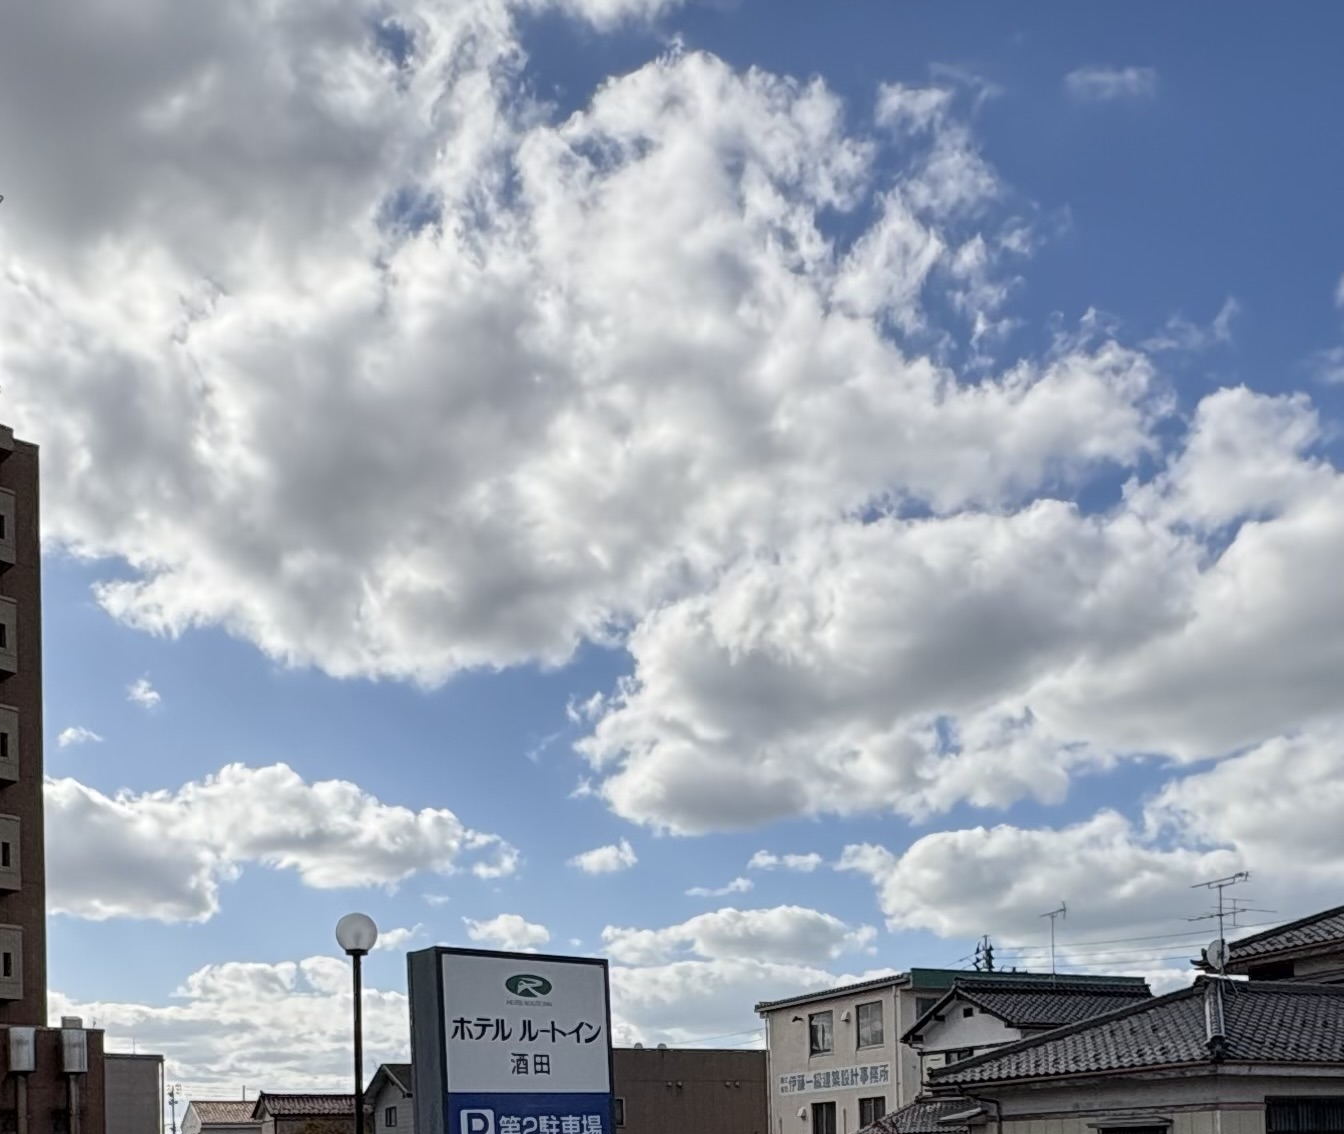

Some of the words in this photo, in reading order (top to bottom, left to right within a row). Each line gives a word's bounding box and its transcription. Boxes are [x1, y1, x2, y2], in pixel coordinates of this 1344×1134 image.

[451, 1017, 513, 1042] ホテル
[518, 1019, 602, 1044] ルートイン
[510, 1052, 551, 1076] 酒田
